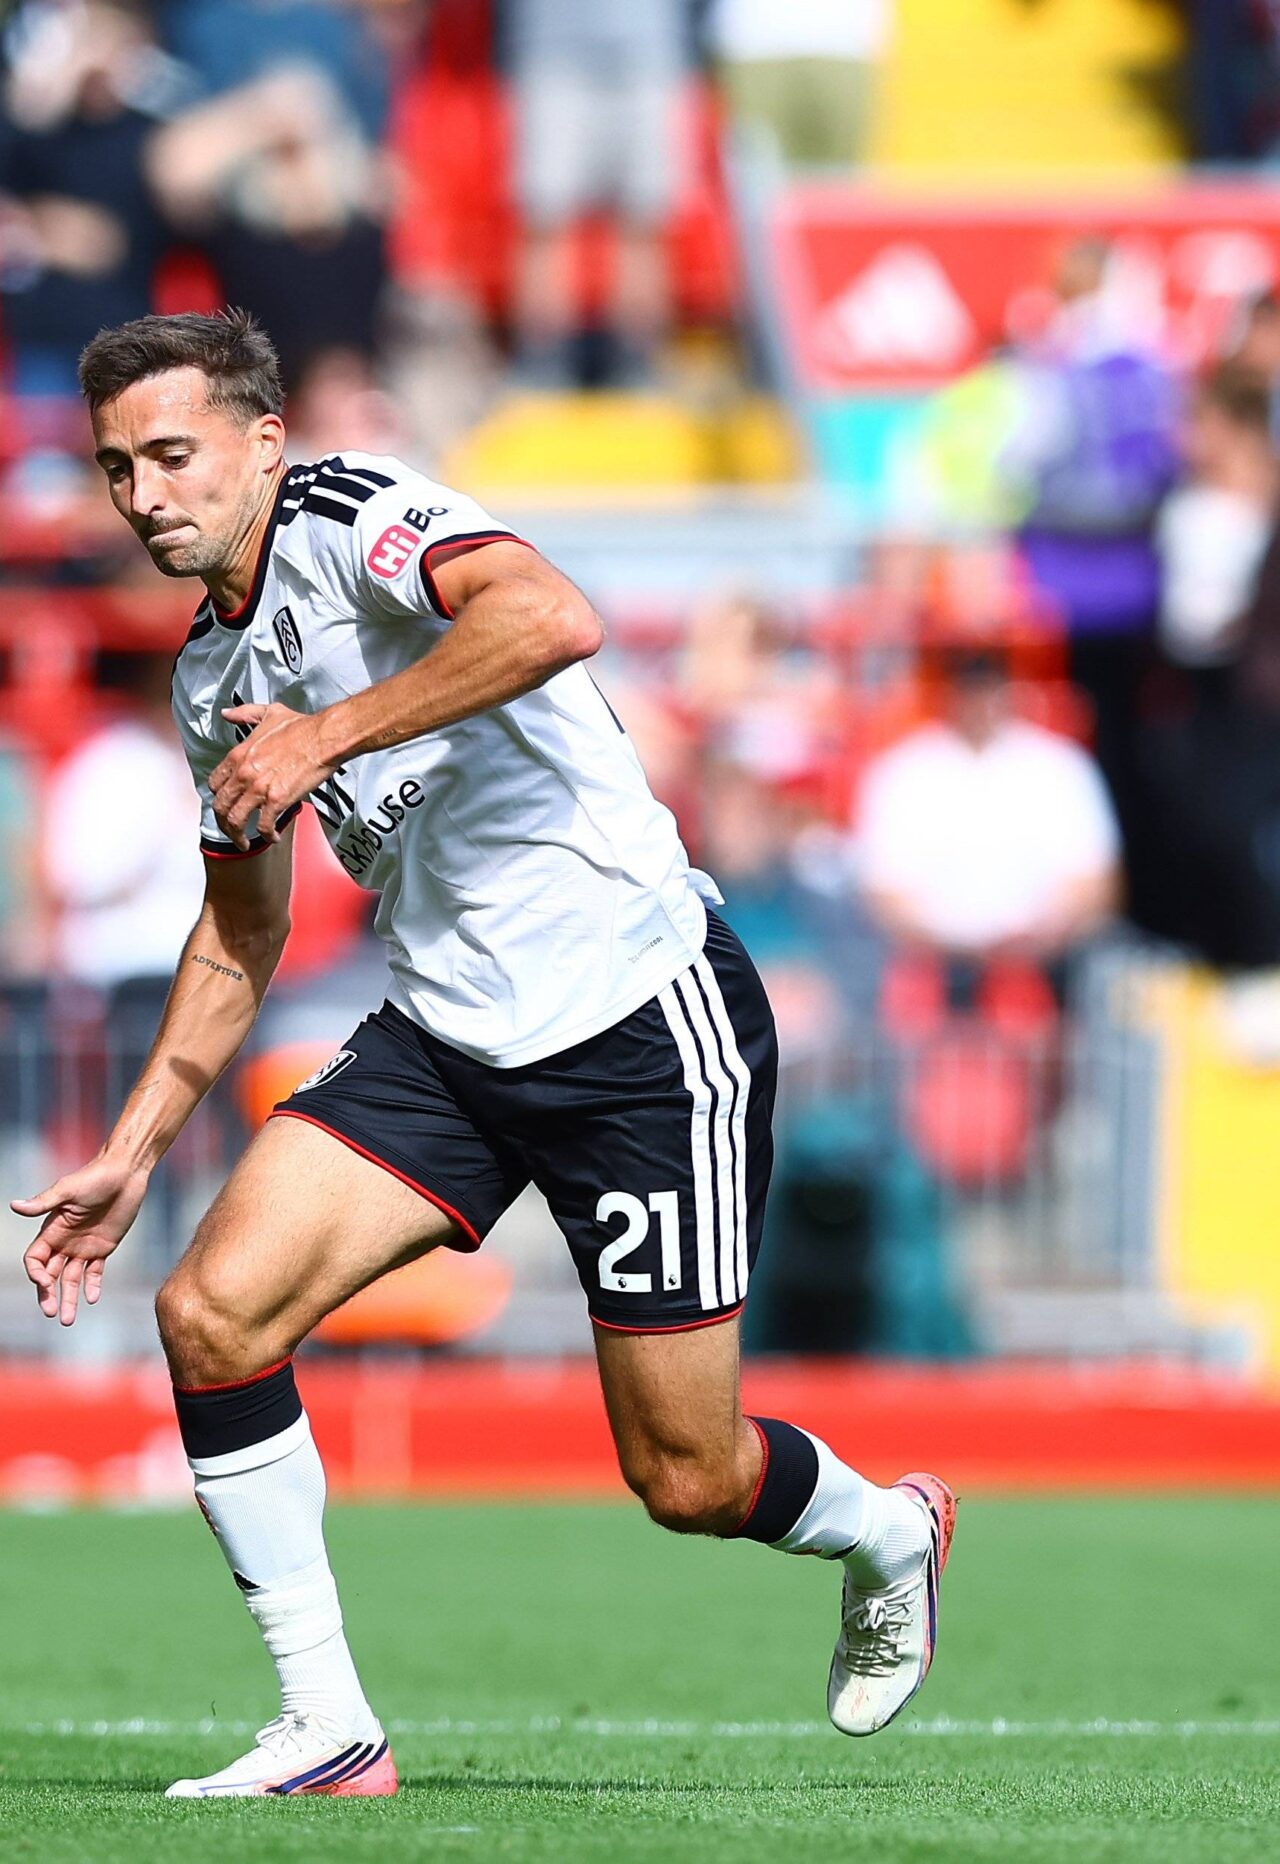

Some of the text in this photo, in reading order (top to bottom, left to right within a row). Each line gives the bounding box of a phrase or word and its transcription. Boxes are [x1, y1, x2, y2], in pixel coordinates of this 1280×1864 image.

[372, 507, 452, 574] Hi Bo
[334, 779, 426, 881] ckhouse
[192, 953, 244, 982] ADVENTURE
[595, 1190, 682, 1293] 21
